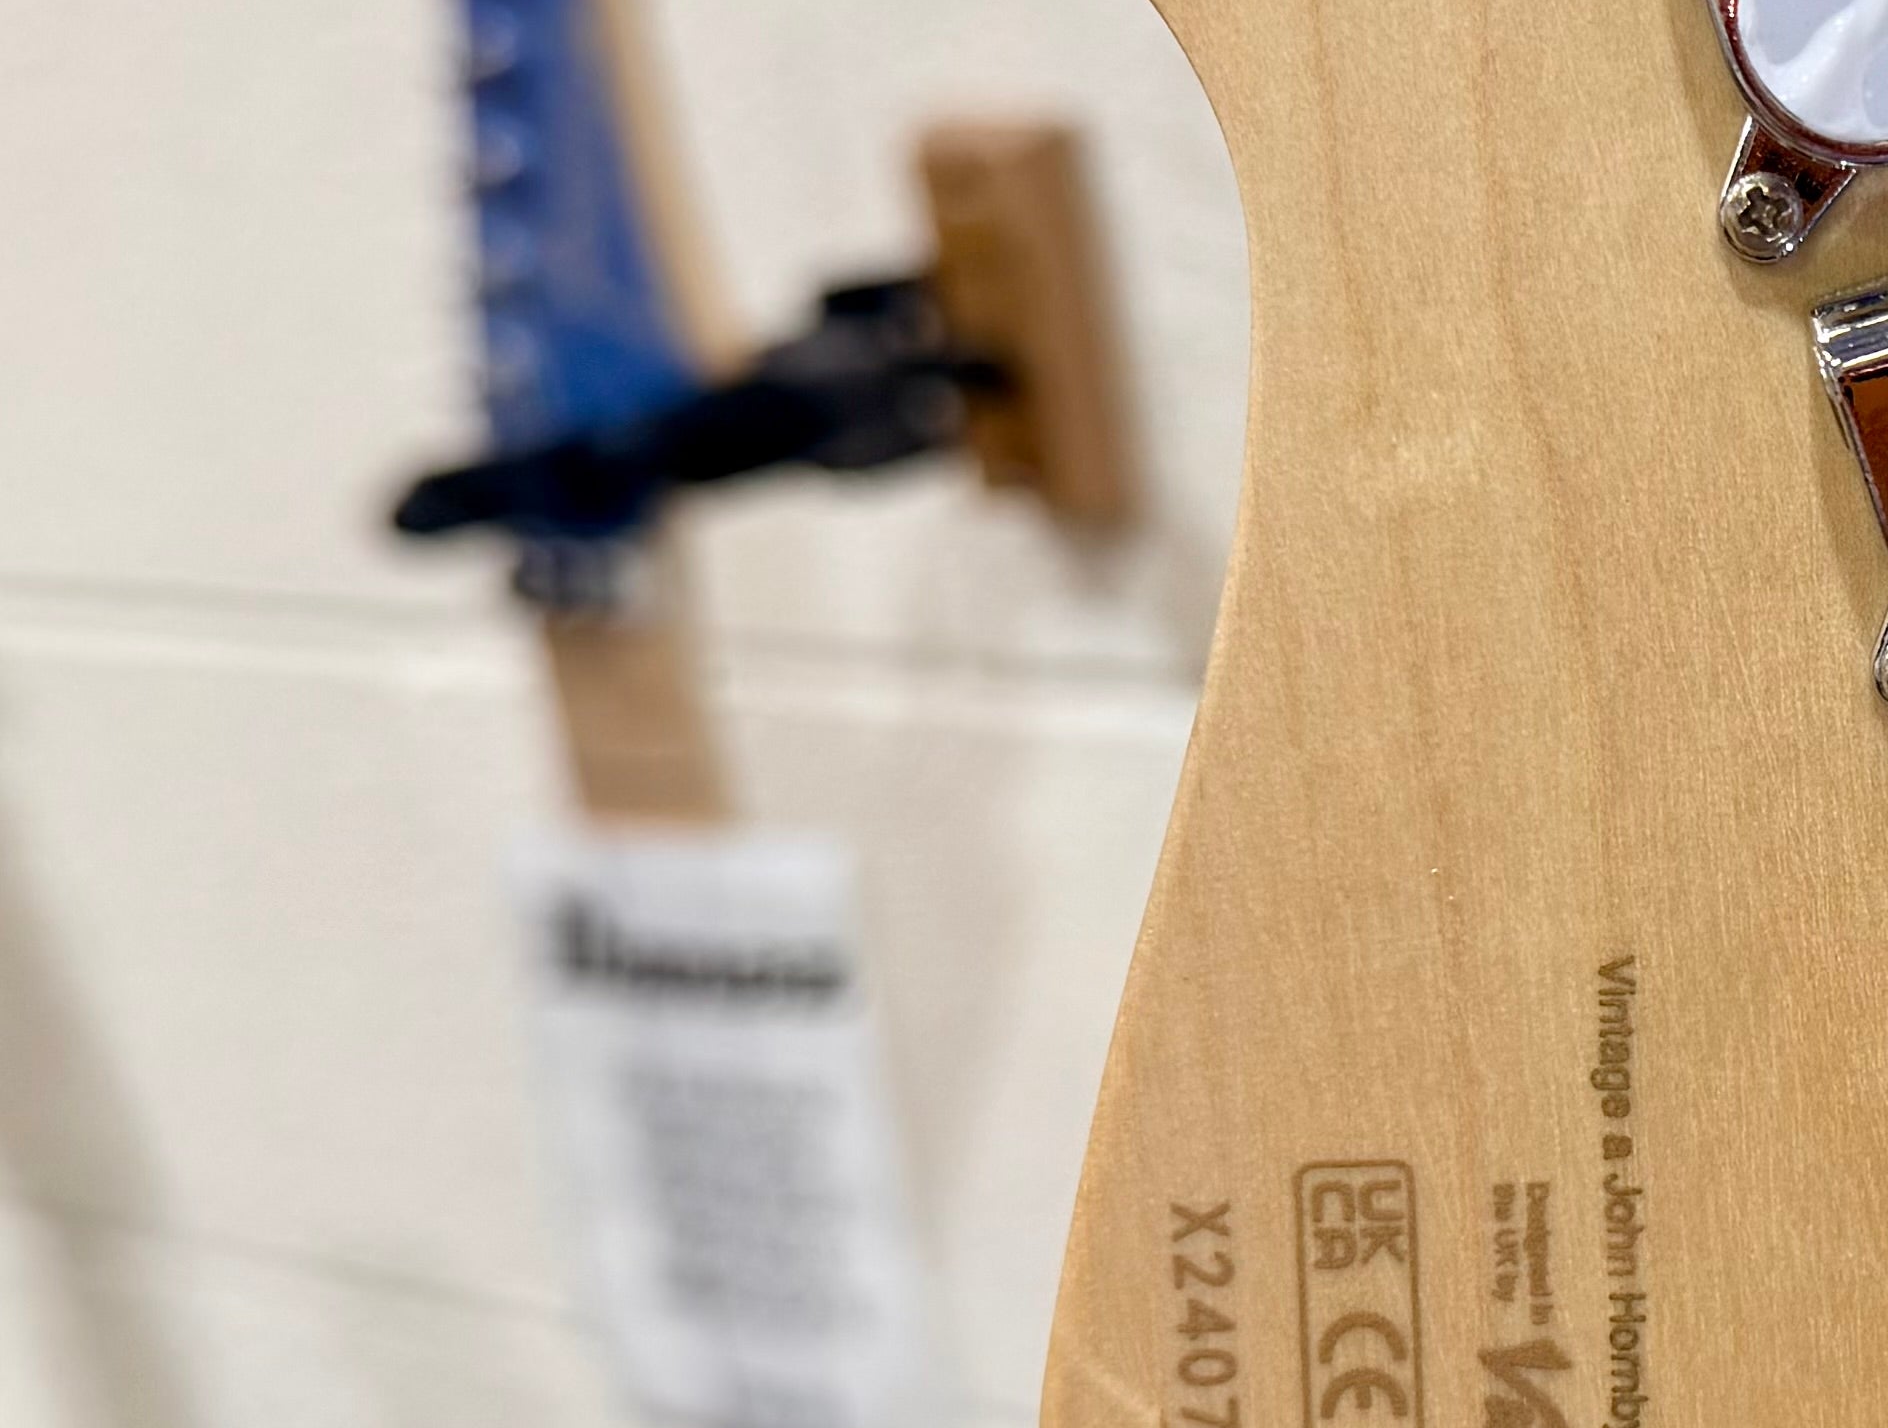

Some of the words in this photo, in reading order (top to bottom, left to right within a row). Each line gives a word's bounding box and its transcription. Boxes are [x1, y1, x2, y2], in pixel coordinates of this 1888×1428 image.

[1590, 954, 1637, 1118] Vintage
[1602, 1134, 1633, 1161] a
[1493, 1228, 1519, 1268] UK
[1602, 1173, 1644, 1277] John
